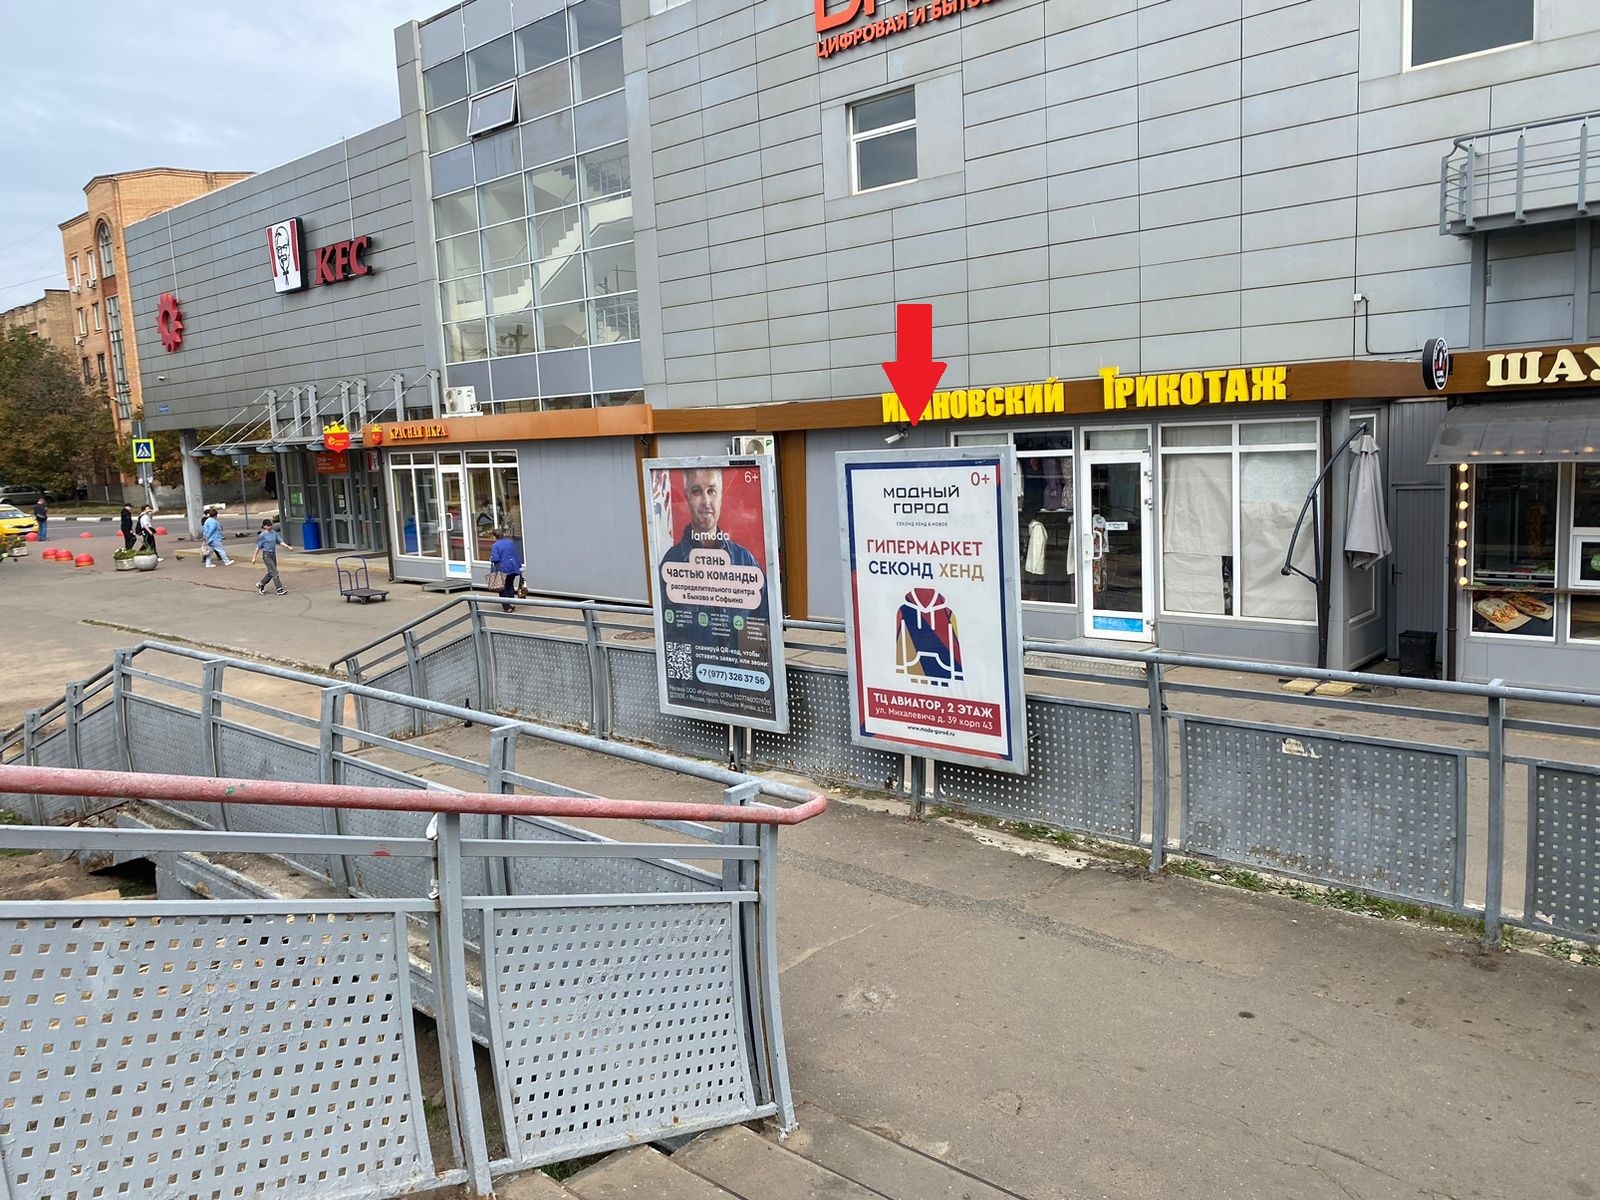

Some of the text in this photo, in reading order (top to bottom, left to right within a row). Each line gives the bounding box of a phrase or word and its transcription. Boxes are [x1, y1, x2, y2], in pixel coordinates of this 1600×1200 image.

[816, 15, 908, 58] ЦИФРОВАЯ
[911, 8, 926, 27] И
[314, 235, 371, 285] KFC
[1098, 366, 1287, 411] ТРИКОТАЖ
[744, 470, 760, 483] 6+
[970, 471, 990, 487] 0+
[883, 485, 960, 498] МОДНЫЙ
[893, 503, 949, 514] ГОРОД
[691, 530, 730, 541] lamoda
[867, 539, 983, 557] ГИПЕРМАРКЕТ
[695, 554, 725, 566] стань
[666, 567, 758, 583] частью команды
[868, 560, 985, 582] СЕКОНД ХЕНД
[670, 584, 755, 596] распределительного центра
[687, 593, 709, 601] Быково
[742, 650, 760, 658] чтобы
[698, 669, 765, 685] +7 (977) 326 37 56
[873, 693, 993, 718] ТЦ АВИАТОР, 2 ЭТАЖ
[875, 707, 993, 730] ул. Михалевича д. 39 корп 43
